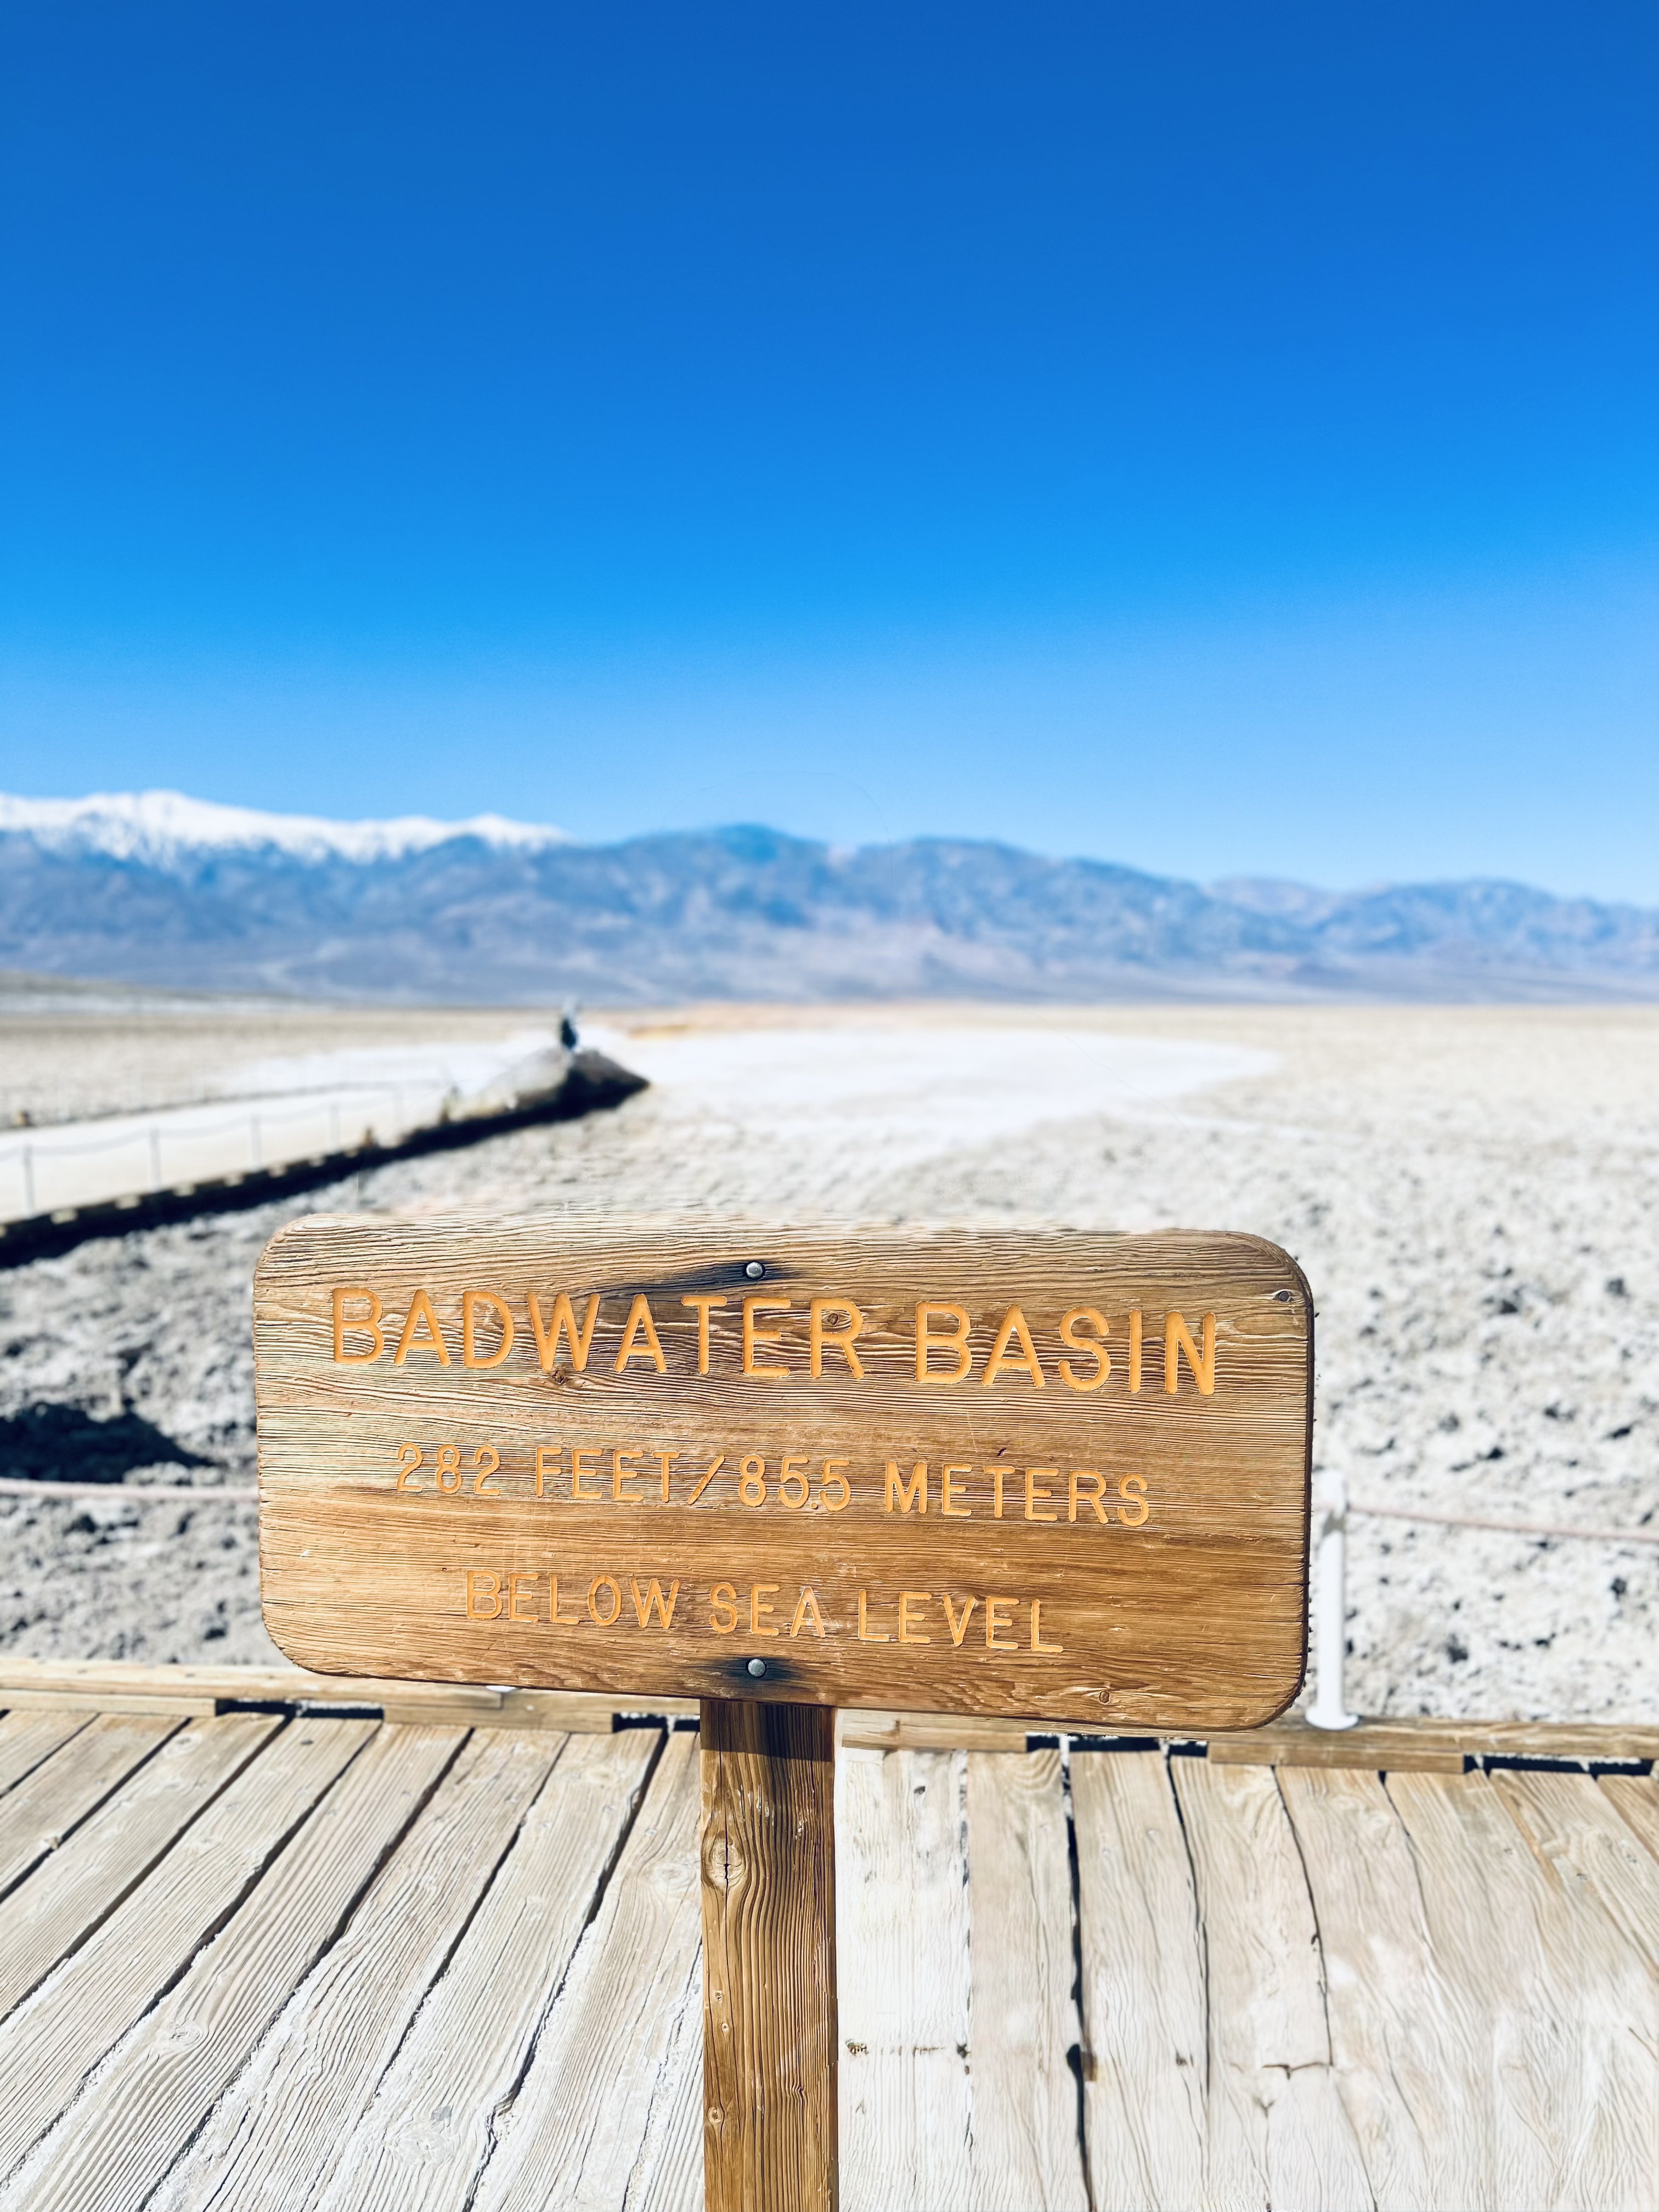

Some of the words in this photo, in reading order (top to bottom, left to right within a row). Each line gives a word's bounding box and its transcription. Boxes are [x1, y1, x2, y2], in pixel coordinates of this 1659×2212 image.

[332, 1288, 865, 1380] BADWATER
[915, 1301, 1216, 1396] BASIN
[397, 1442, 501, 1497] 282
[884, 1460, 1149, 1527] METERS
[466, 1569, 680, 1630] BELOW
[709, 1582, 826, 1639] SEA
[857, 1588, 1064, 1654] LEVEL
